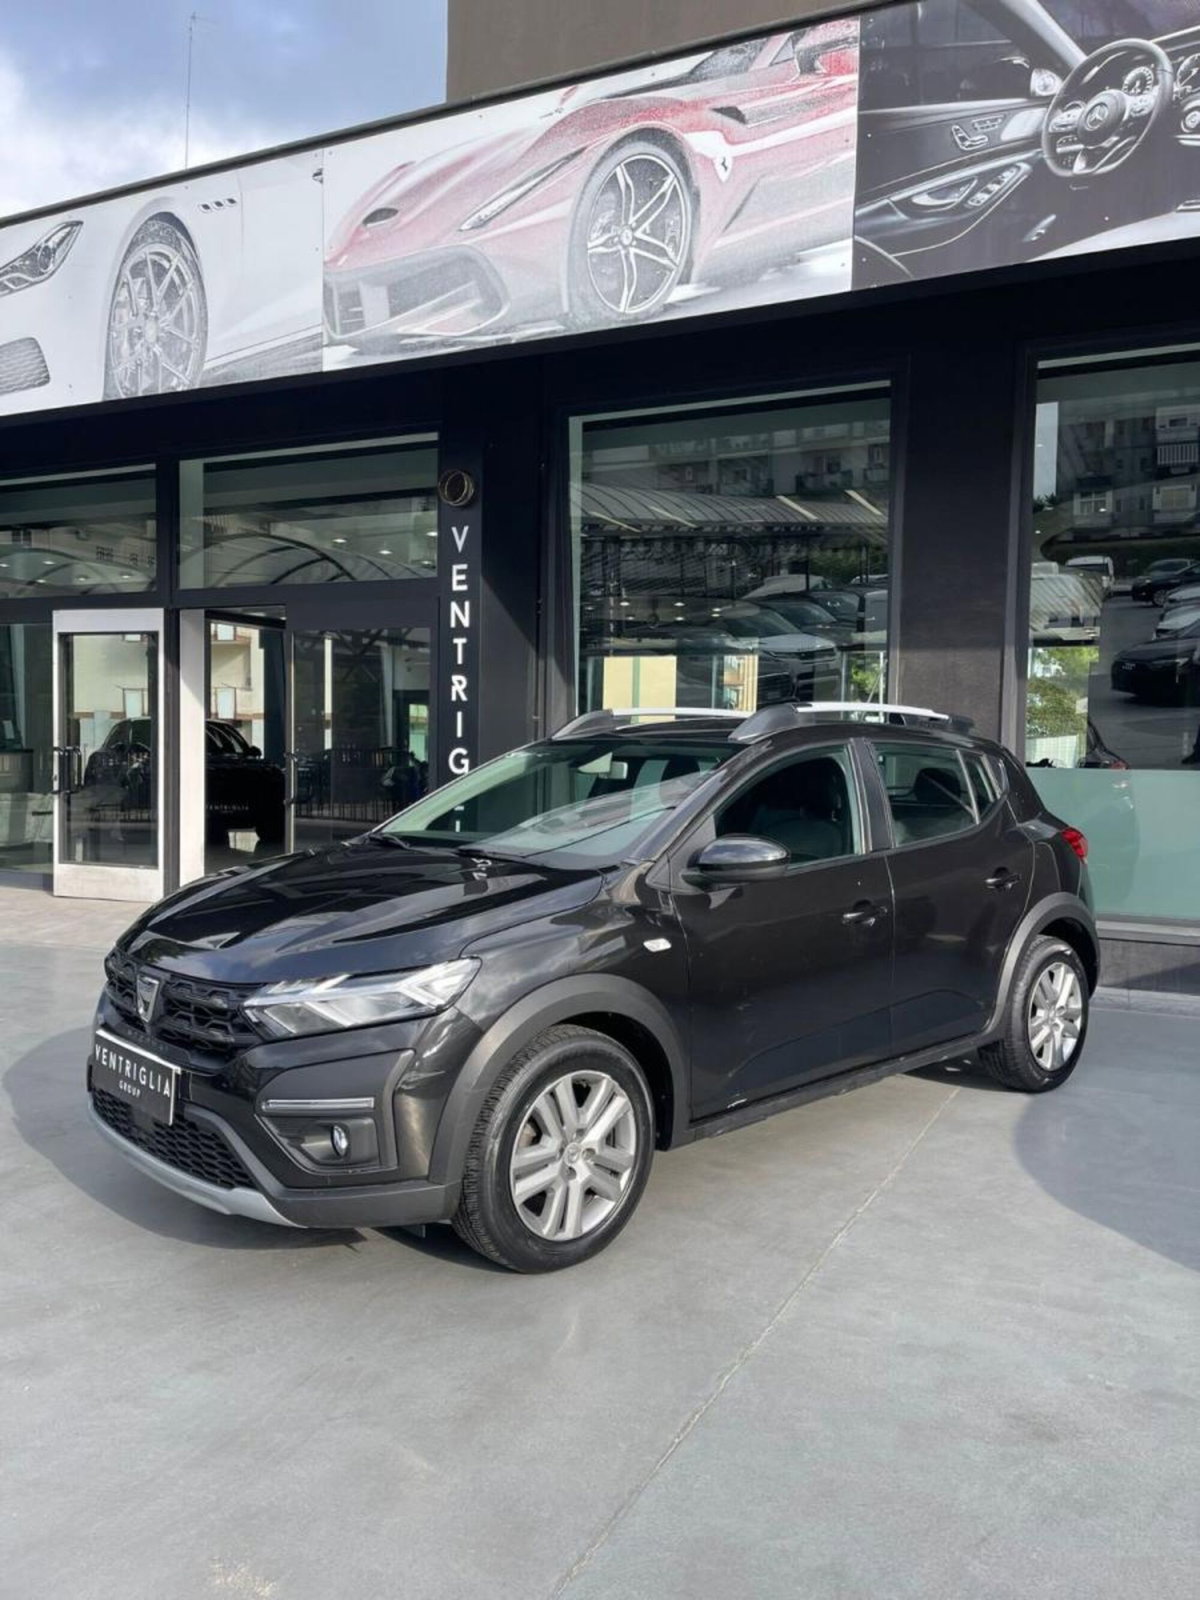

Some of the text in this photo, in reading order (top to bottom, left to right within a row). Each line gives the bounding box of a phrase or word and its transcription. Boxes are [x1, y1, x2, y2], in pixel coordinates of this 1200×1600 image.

[448, 525, 470, 833] VENTRIG
[95, 1043, 171, 1098] VENTRIGLIA
[118, 1080, 141, 1098] GROUP
